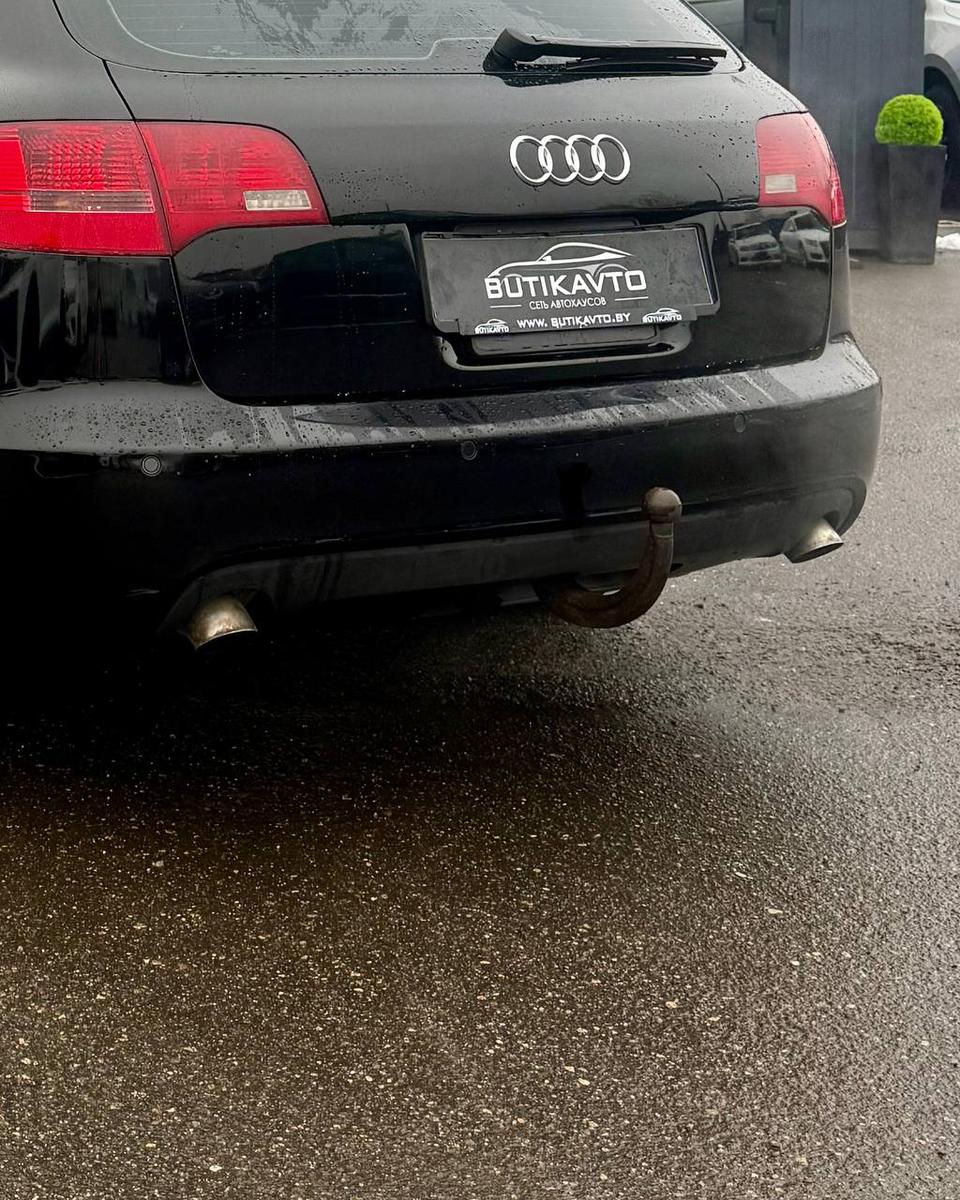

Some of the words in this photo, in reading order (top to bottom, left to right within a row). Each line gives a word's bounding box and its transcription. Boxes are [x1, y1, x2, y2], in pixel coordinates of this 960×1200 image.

[484, 270, 647, 299] BUTIKAVTO
[529, 300, 549, 310] СЕТЬ
[550, 297, 607, 309] АВТОХАУСОВ
[550, 312, 631, 328] BUTIKAVTO.BY
